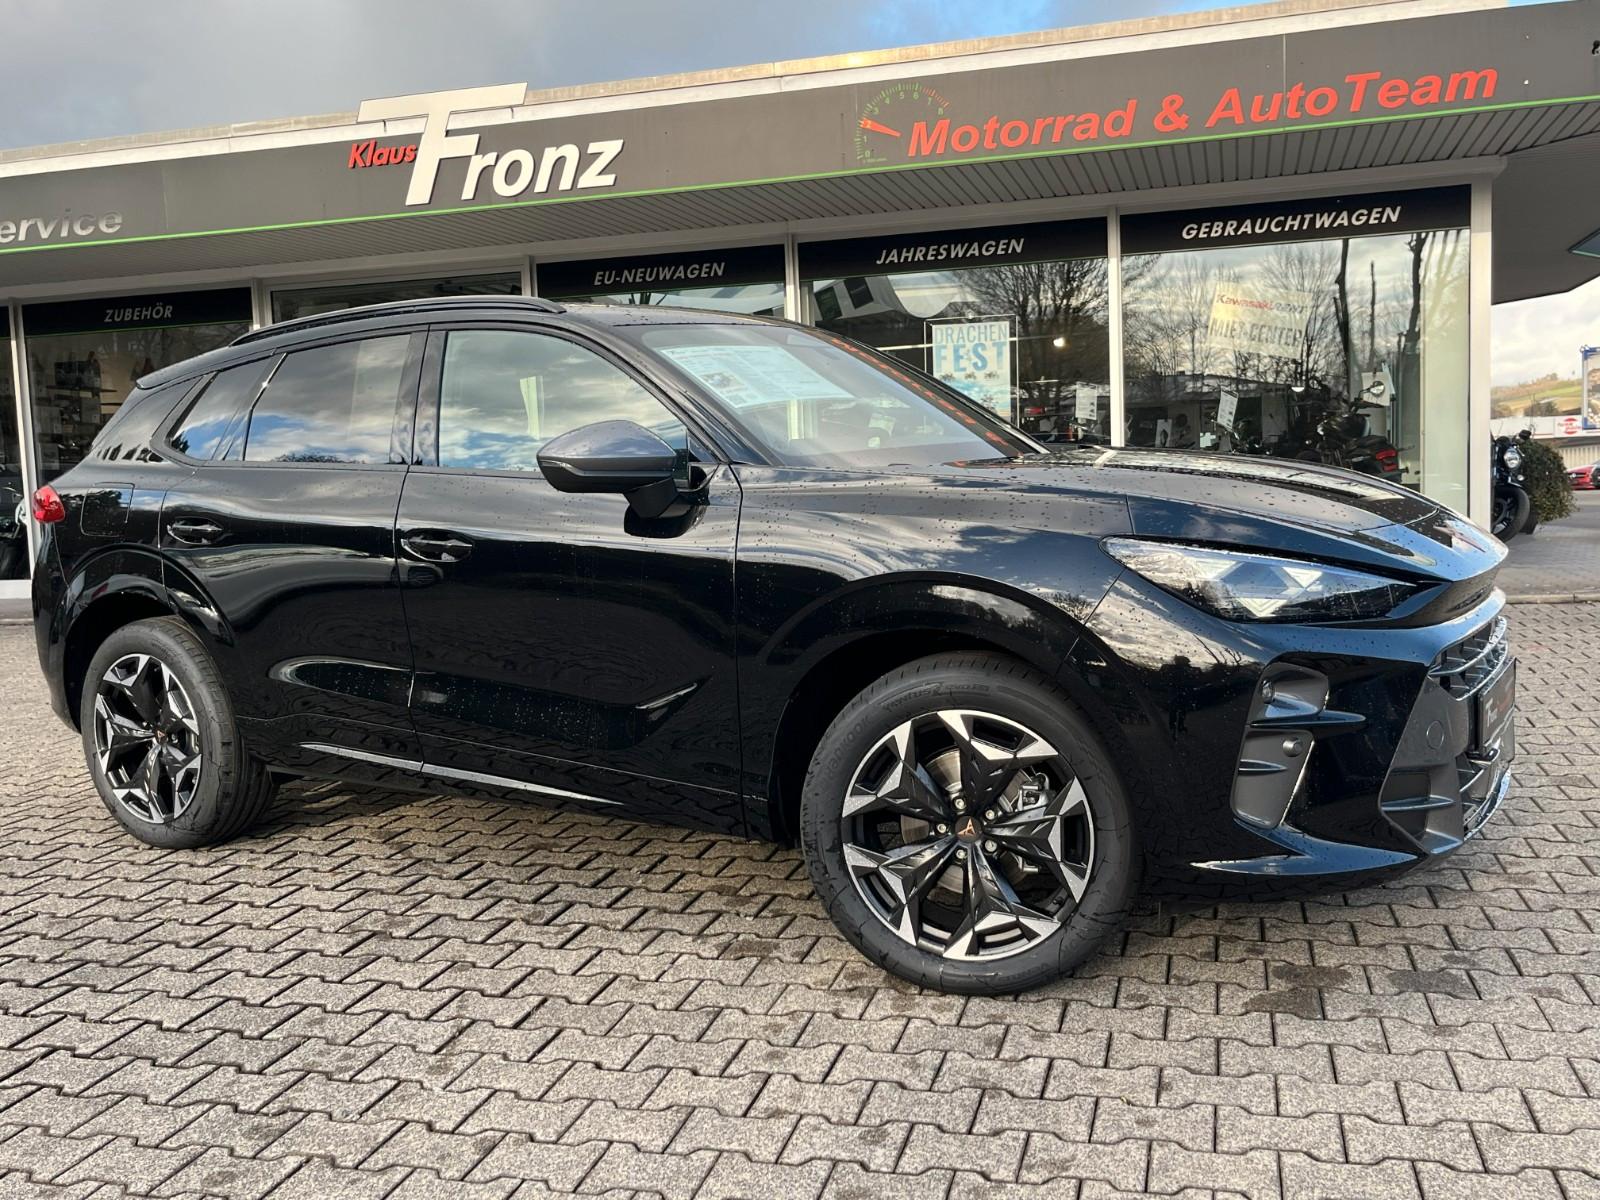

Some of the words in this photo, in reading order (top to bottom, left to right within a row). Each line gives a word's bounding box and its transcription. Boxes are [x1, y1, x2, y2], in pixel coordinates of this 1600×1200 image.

[908, 98, 1137, 157] Motorrad
[1153, 92, 1190, 133] &
[348, 139, 417, 169] Klaus
[356, 82, 625, 206] Fronz
[1182, 206, 1402, 239] GEBRAUCHTWAGEN
[876, 238, 1025, 265] JAHRESWAGEN
[593, 262, 725, 286] EU-NEUWAGEN
[104, 302, 173, 322] ZUBEHÖR
[934, 324, 1007, 345] DRACHEN
[935, 341, 1007, 373] FEST
